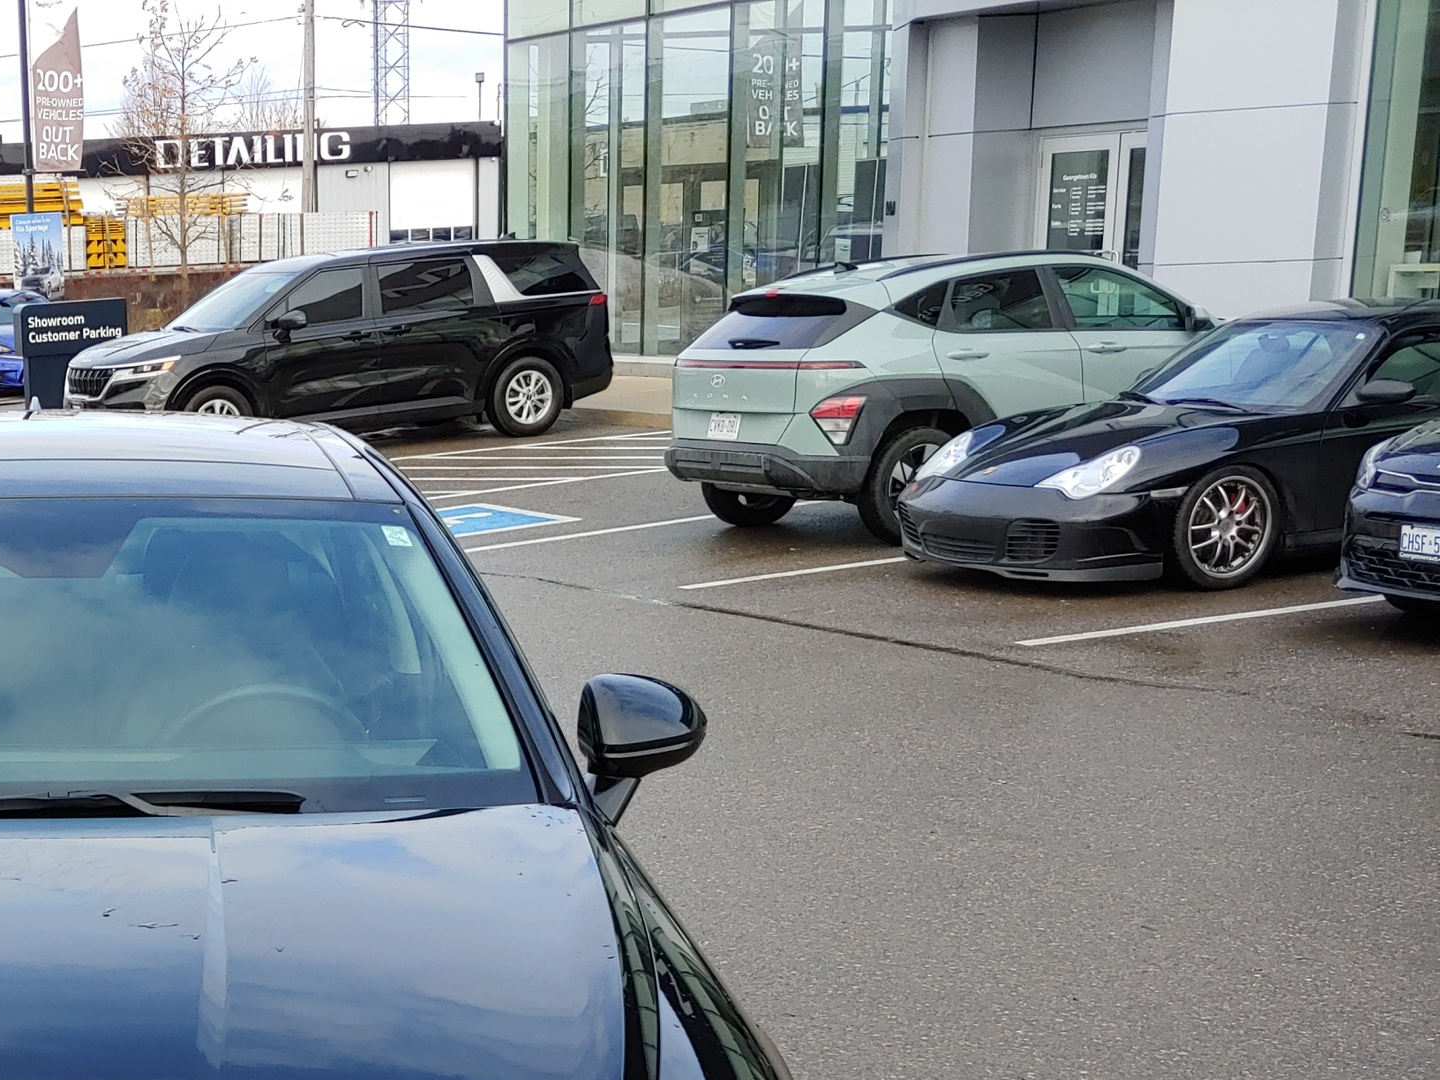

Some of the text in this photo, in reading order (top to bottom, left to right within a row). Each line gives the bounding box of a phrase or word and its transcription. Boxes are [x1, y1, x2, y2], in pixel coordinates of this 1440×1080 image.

[752, 53, 800, 75] 20+
[36, 69, 83, 93] 200+
[36, 96, 84, 107] PRE-OWNED
[758, 106, 792, 121] OT
[42, 126, 75, 143] OUT
[39, 143, 80, 161] BACK
[25, 224, 49, 232] Sportage
[27, 315, 85, 328] Showroom
[28, 326, 122, 343] Customer Parking
[692, 392, 748, 400] KONA
